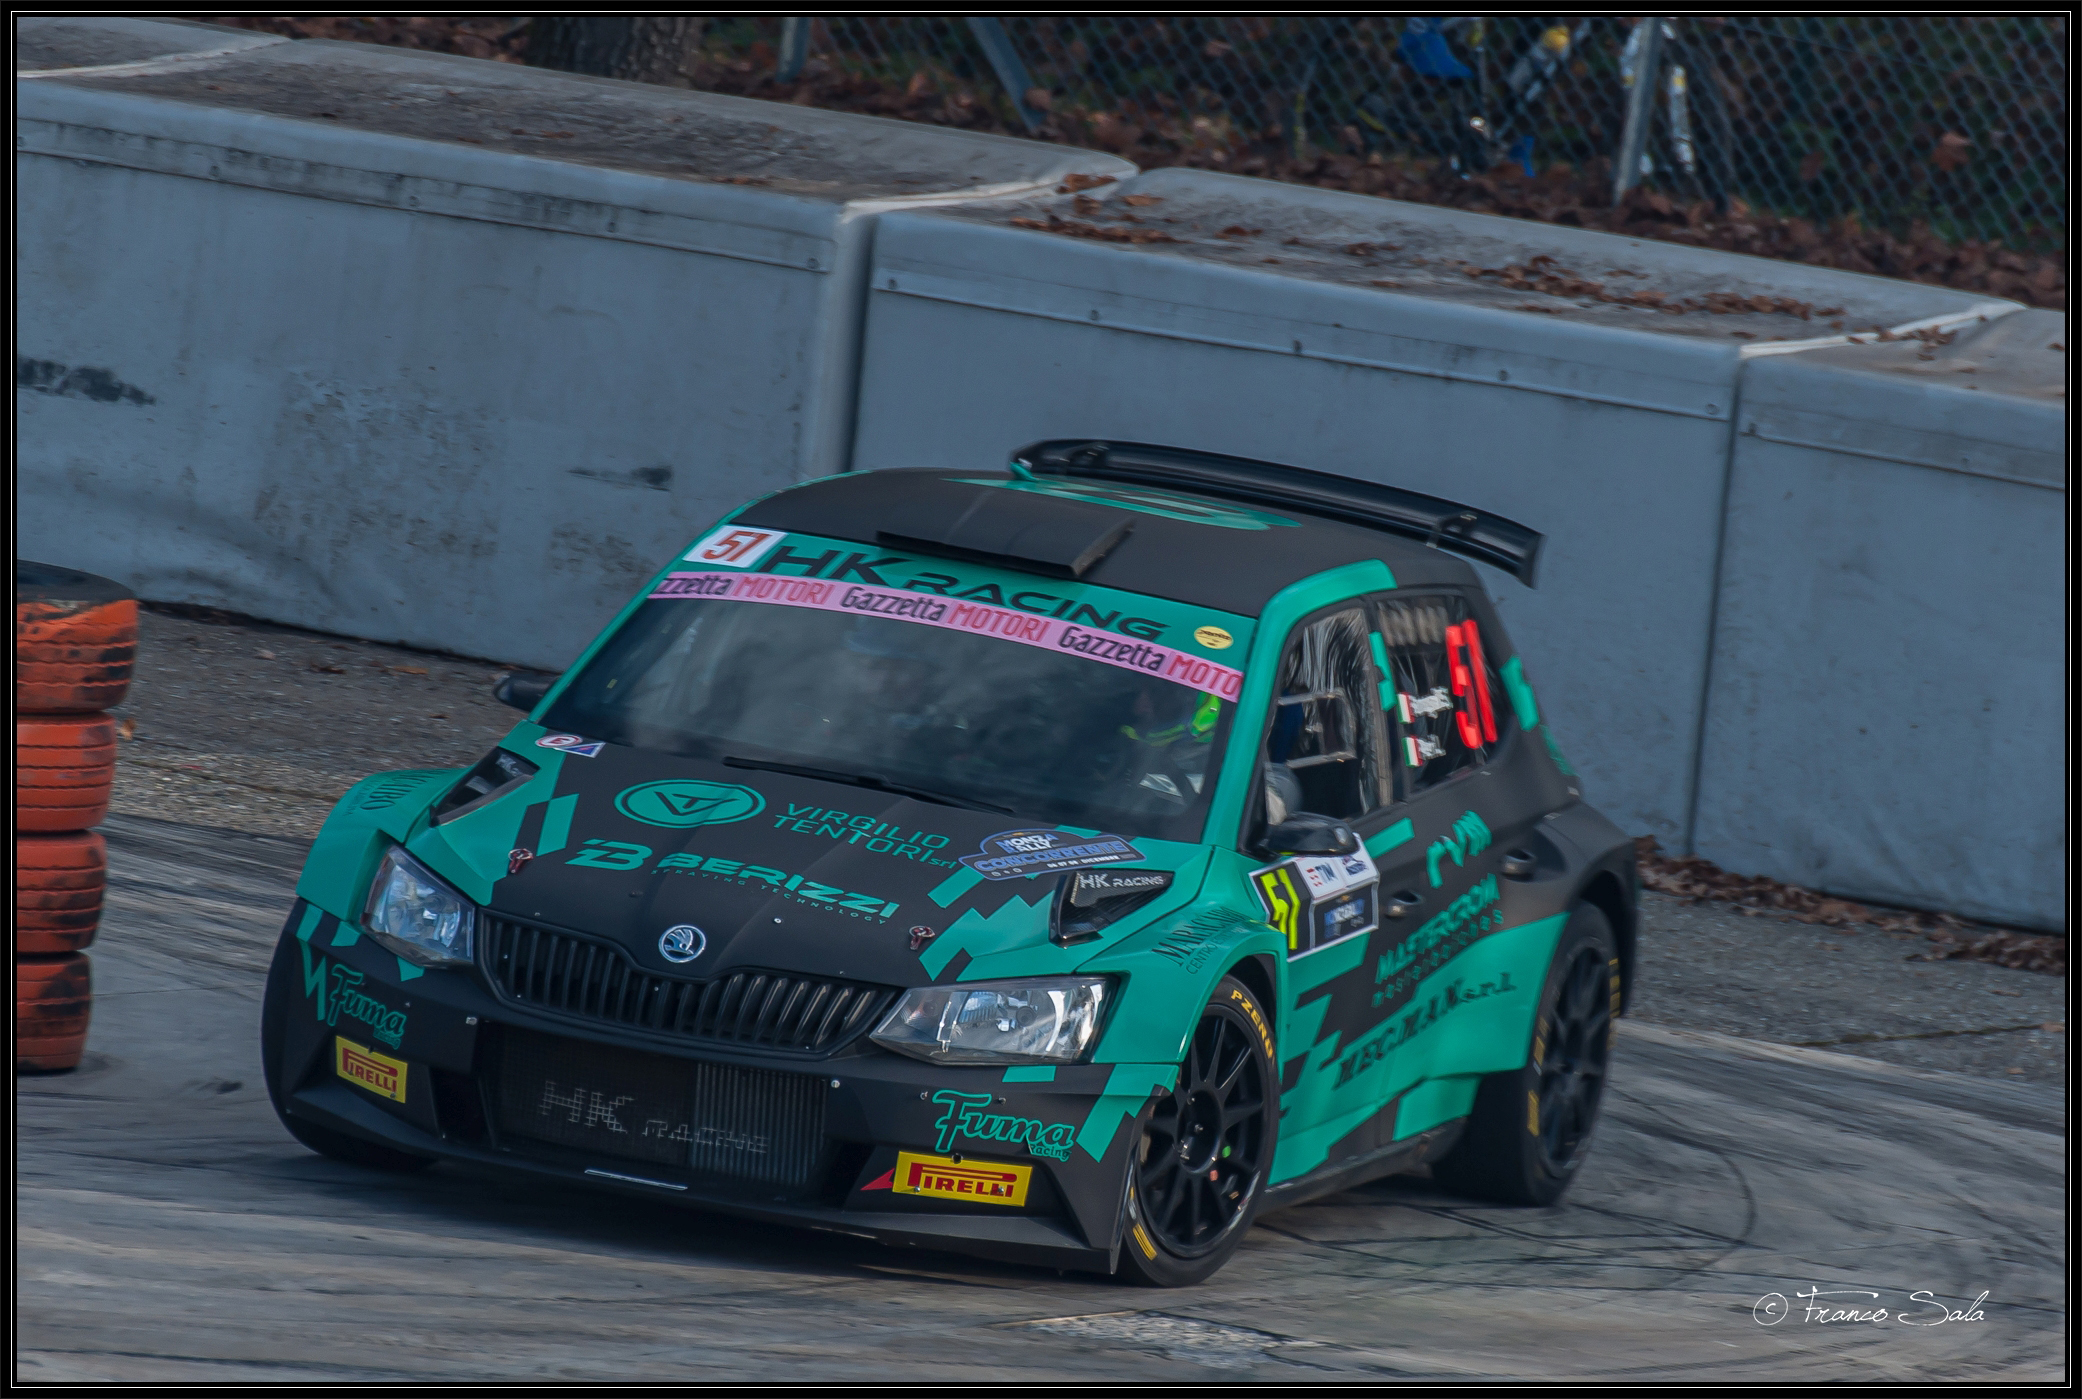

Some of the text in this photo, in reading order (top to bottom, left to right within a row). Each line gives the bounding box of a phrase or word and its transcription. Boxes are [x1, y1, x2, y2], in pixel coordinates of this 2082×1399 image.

[757, 545, 1171, 641] HK RACING
[731, 575, 835, 605] MOTORI
[840, 586, 948, 622] Gazzetta
[947, 603, 1051, 642] MOTORI
[1057, 626, 1166, 671] Gazzetta
[774, 814, 935, 863] TENTORI
[787, 803, 950, 849] VIRGILIO
[995, 833, 1059, 851] MONZA
[974, 840, 1132, 872] CONCORRENTE
[1079, 873, 1165, 889] HK RACING
[651, 868, 887, 925] SPRAYING TECHNOLOGY
[656, 853, 900, 919] BERIZZI
[327, 963, 408, 1038] Fuma
[342, 1047, 399, 1093] PIRELLI
[537, 1080, 635, 1133] HK
[931, 1089, 1075, 1153] Fuma
[907, 1162, 1018, 1198] PIRELLI
